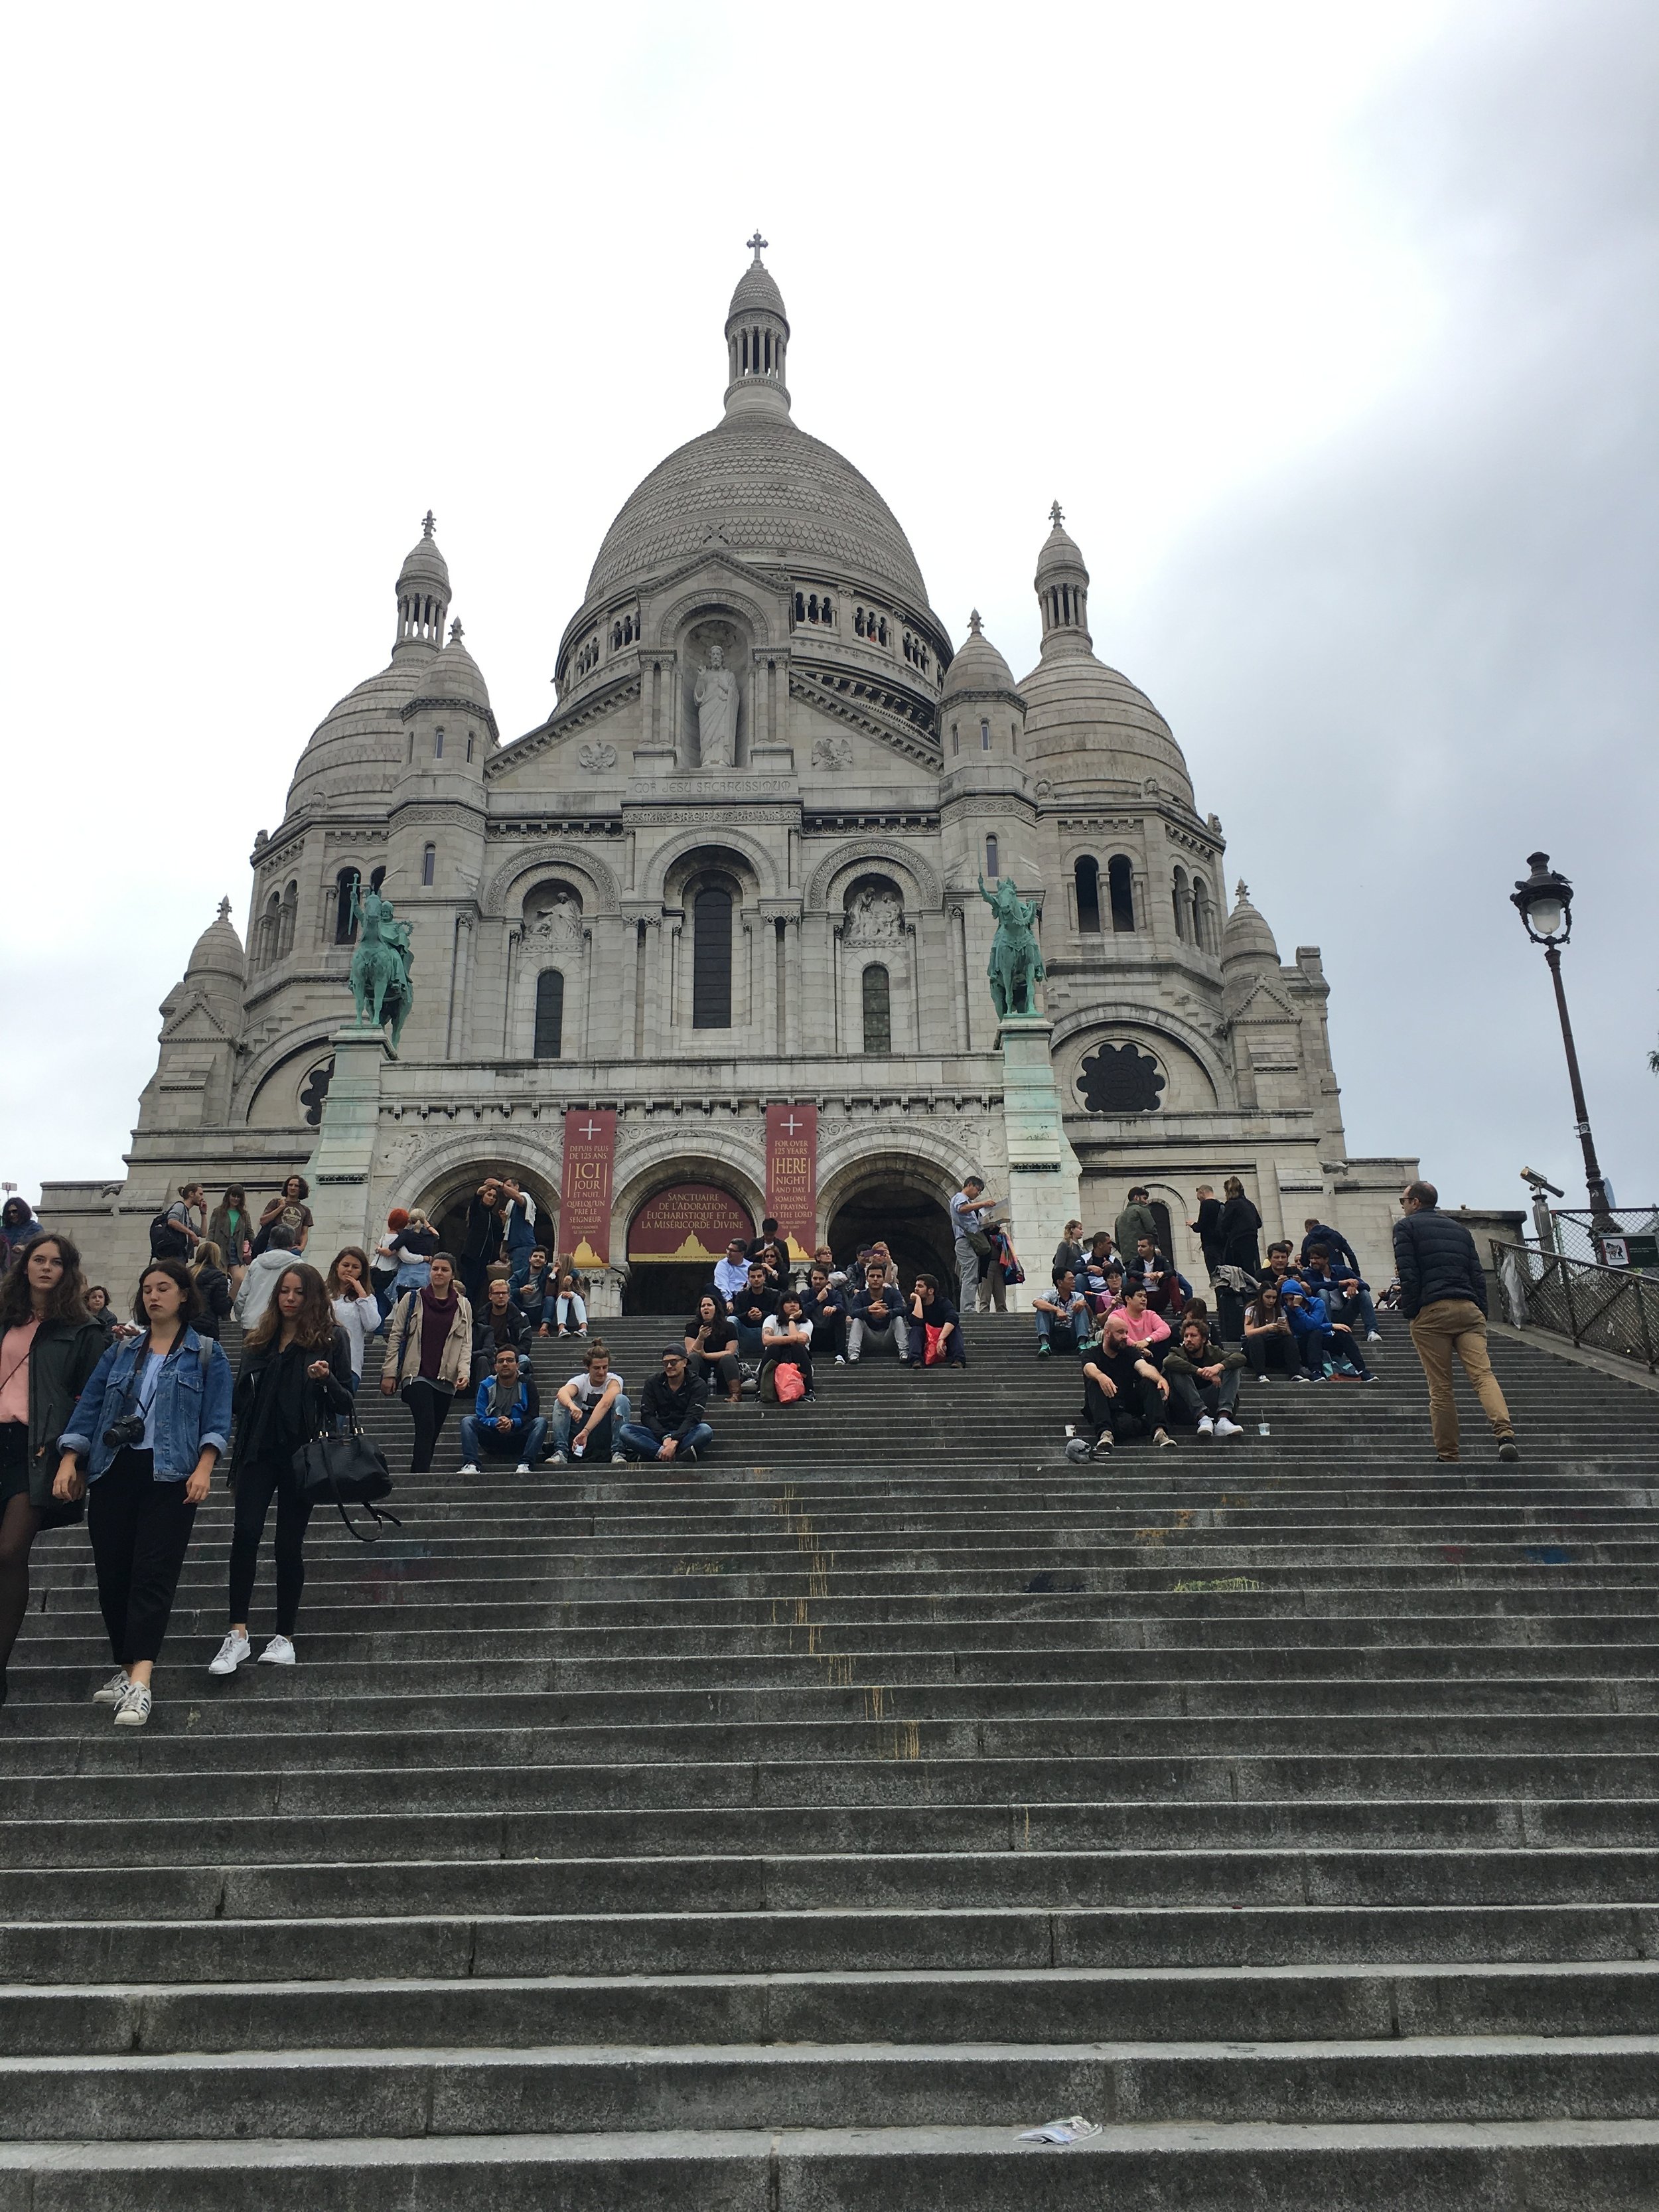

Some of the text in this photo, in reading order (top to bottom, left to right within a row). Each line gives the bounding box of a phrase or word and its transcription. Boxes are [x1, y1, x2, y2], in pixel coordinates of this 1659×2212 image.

[634, 781, 791, 793] COR JESU SACRATISSIMUM
[575, 1163, 601, 1179] ICI
[776, 1157, 807, 1174] HERE
[574, 1180, 601, 1192] JOUR
[776, 1176, 806, 1185] NIGHT
